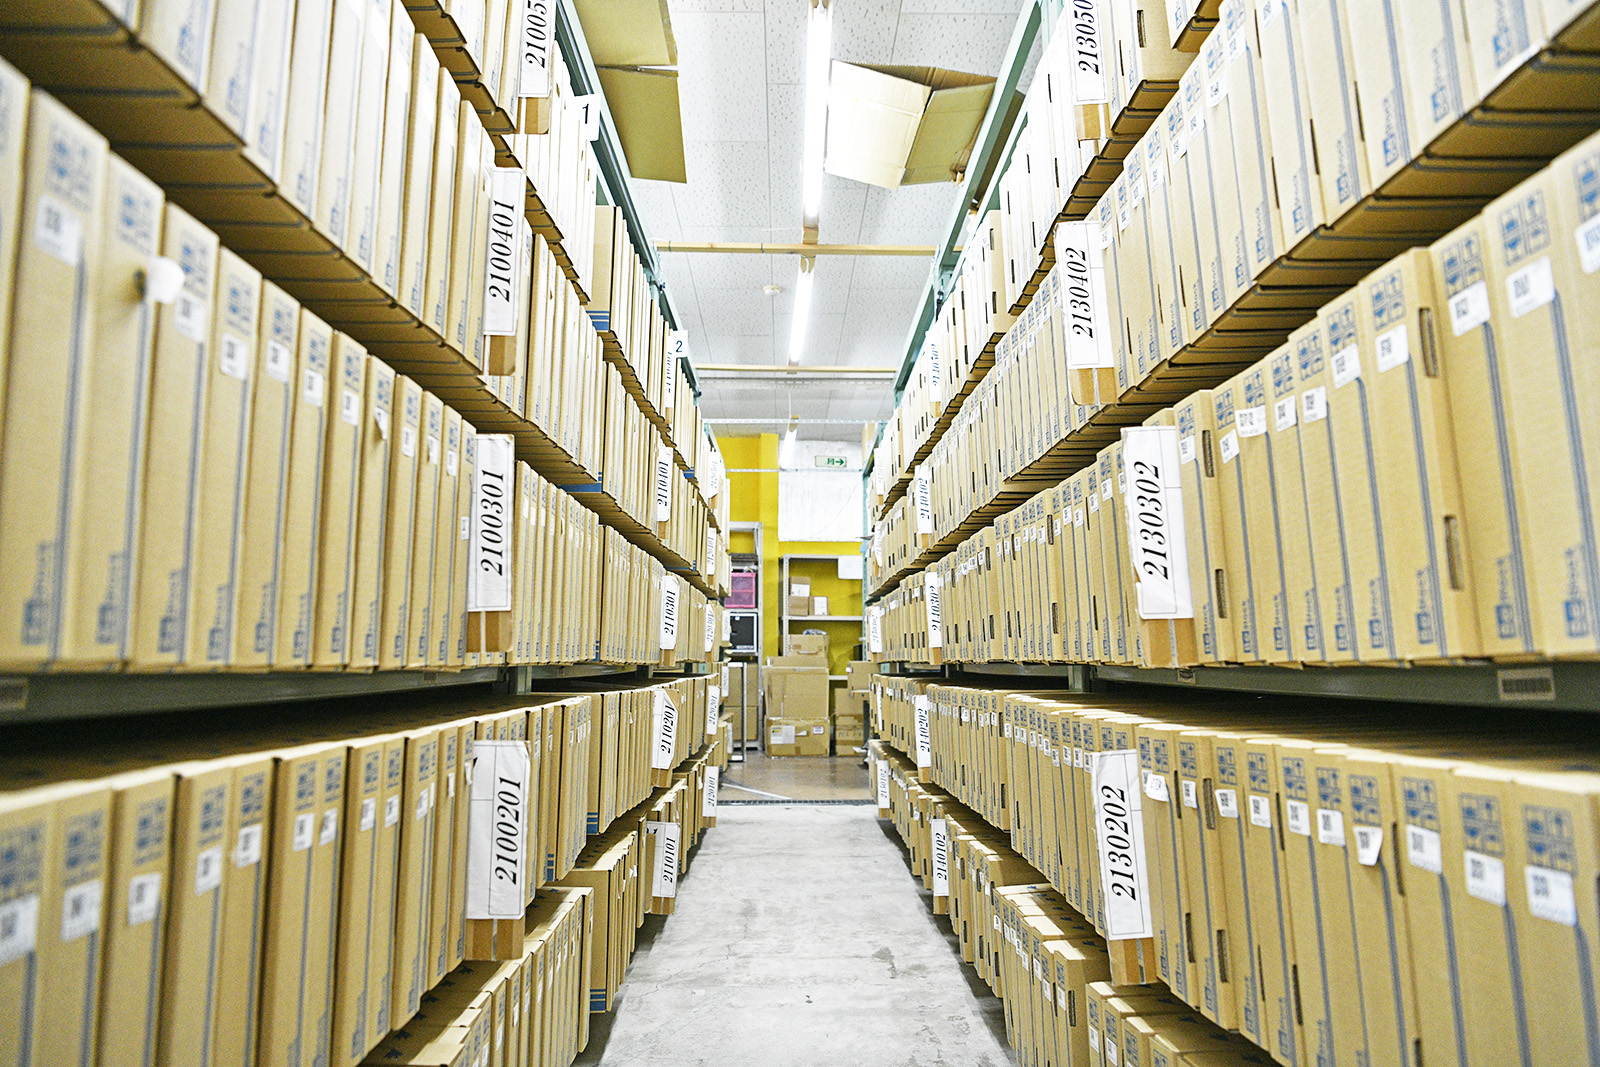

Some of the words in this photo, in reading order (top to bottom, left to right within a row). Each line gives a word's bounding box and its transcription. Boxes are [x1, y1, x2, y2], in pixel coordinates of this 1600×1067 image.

[525, 0, 547, 69] 21005
[582, 103, 590, 125] 1
[488, 200, 515, 303] 2100401
[1065, 247, 1094, 339] 2130402
[675, 340, 683, 353] 2
[656, 460, 669, 507] 2110401
[918, 477, 930, 520] 2140402
[480, 469, 504, 577] 2100301
[1133, 461, 1169, 580] 2130302
[664, 590, 676, 636] 2110301
[929, 585, 941, 632] 2140302
[660, 703, 676, 754] 2110201
[708, 695, 718, 725] 2120201
[917, 708, 930, 753] 2140202
[707, 776, 716, 807] 2120101
[494, 776, 521, 886] 2100201
[1101, 785, 1137, 902] 2130202
[662, 837, 676, 883] 2110101
[935, 832, 948, 881] 2140102
